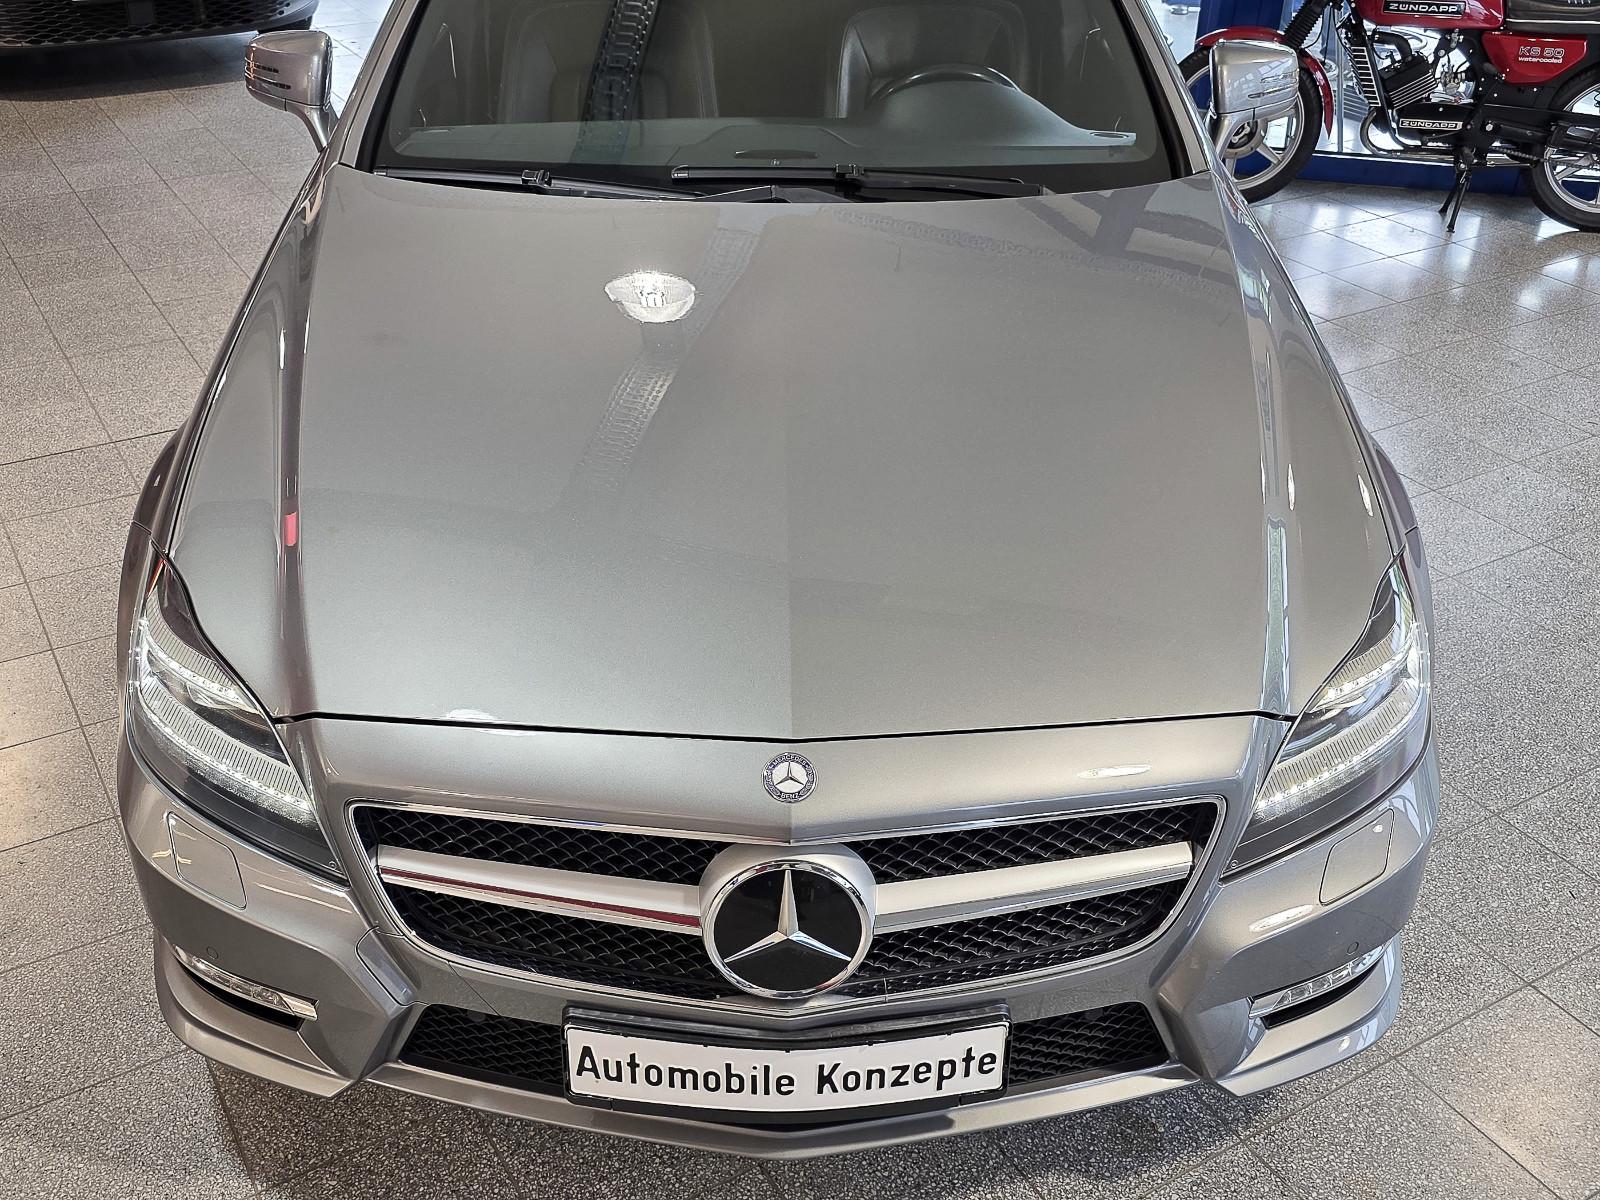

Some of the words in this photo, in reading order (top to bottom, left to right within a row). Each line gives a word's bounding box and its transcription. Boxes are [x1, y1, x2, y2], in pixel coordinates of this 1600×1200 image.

[1389, 3, 1458, 12] ZÜNDAPP
[1519, 46, 1541, 56] KS
[1544, 47, 1565, 58] 50
[1402, 120, 1456, 128] ZÜNDAPP
[575, 1045, 795, 1096] Automobile
[816, 1046, 998, 1095] Konzepte
